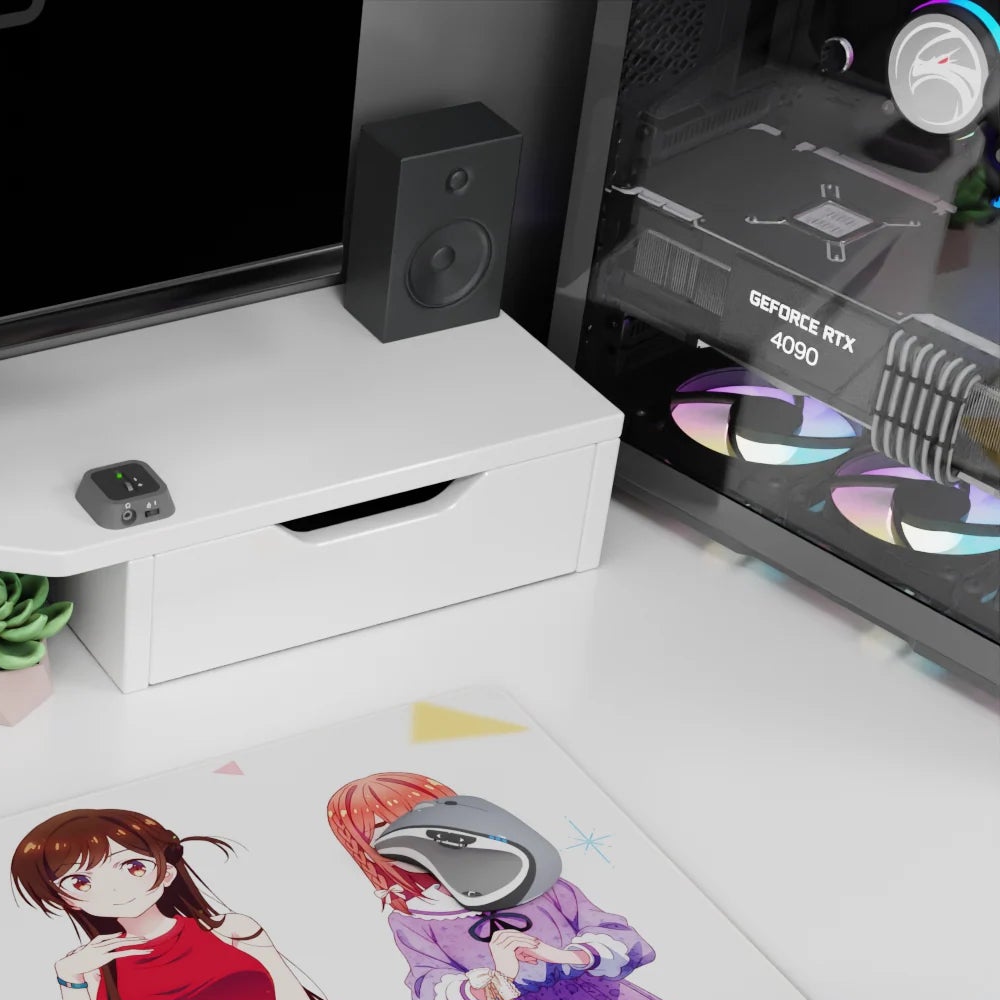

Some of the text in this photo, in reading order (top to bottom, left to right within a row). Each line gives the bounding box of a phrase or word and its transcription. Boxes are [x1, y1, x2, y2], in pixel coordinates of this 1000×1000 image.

[749, 289, 856, 353] GEFORCE RTX
[770, 331, 819, 366] 4090
